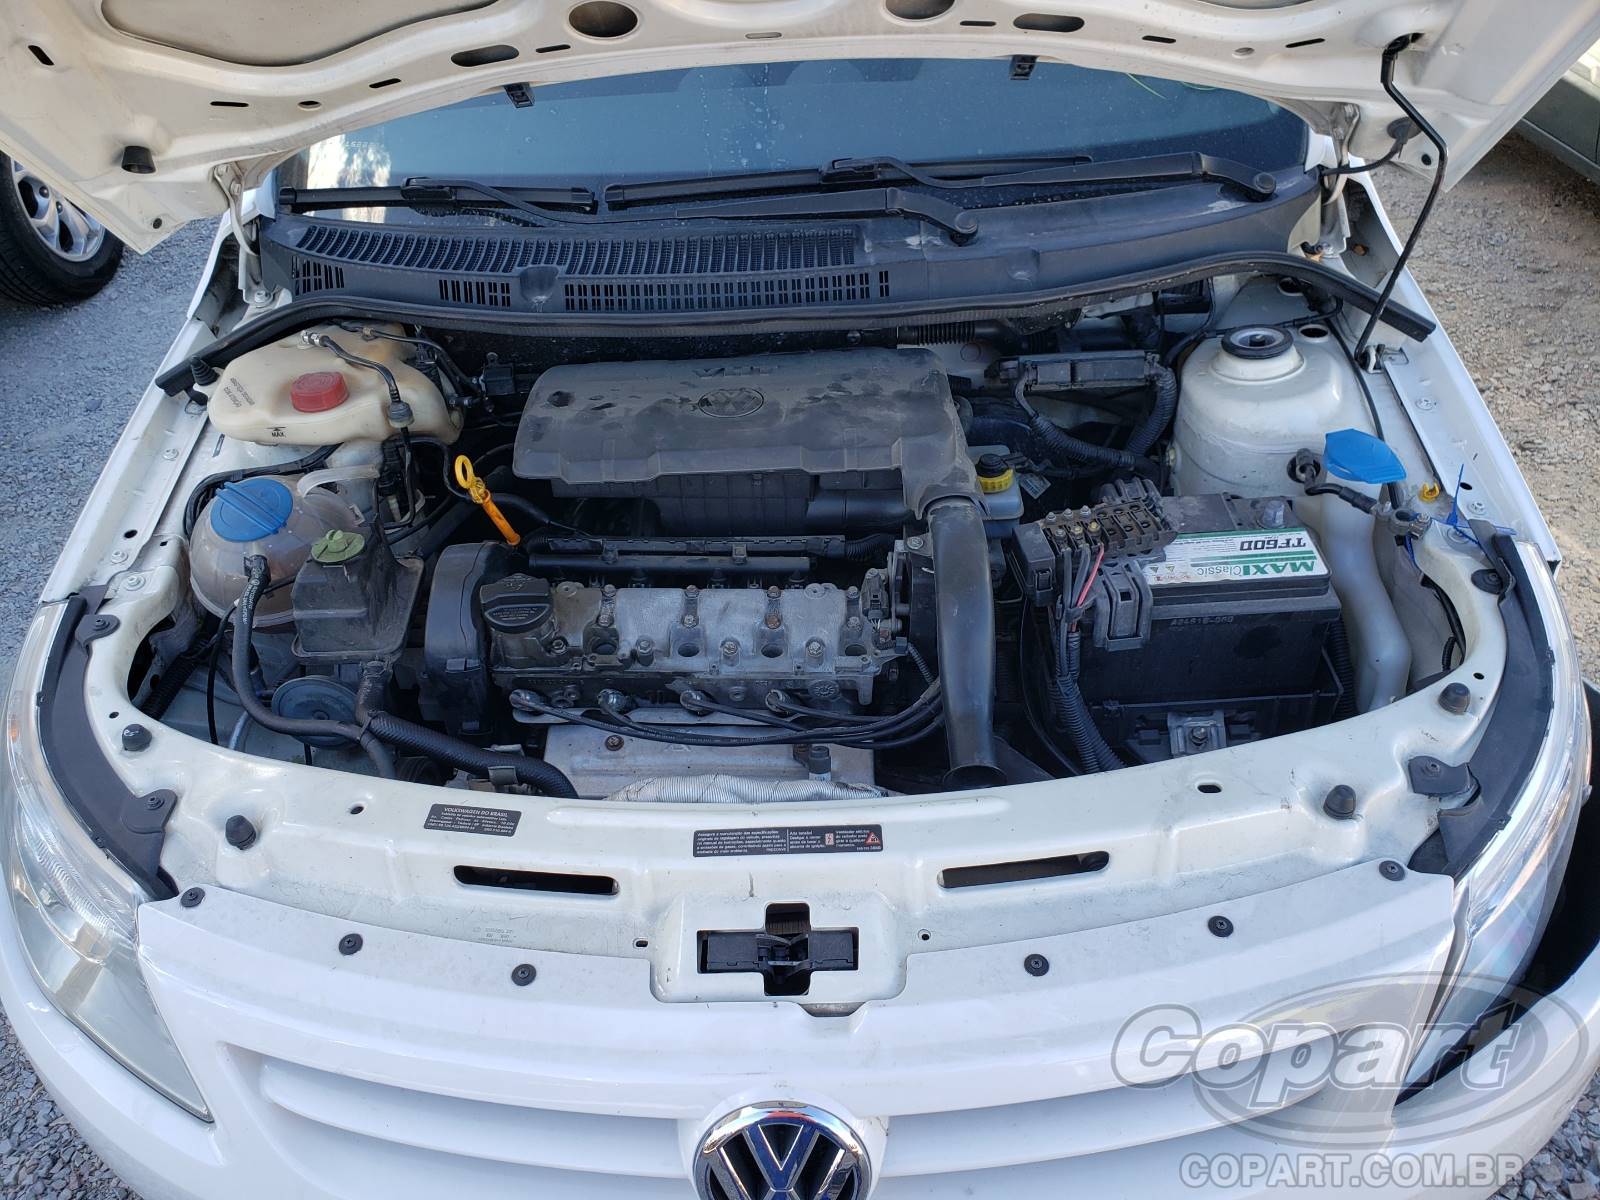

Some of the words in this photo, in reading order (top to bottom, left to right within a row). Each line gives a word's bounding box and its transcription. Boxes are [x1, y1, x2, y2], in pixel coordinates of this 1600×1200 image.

[1239, 537, 1307, 551] TF60D
[1197, 563, 1242, 577] Classic
[1242, 560, 1316, 577] MAXI
